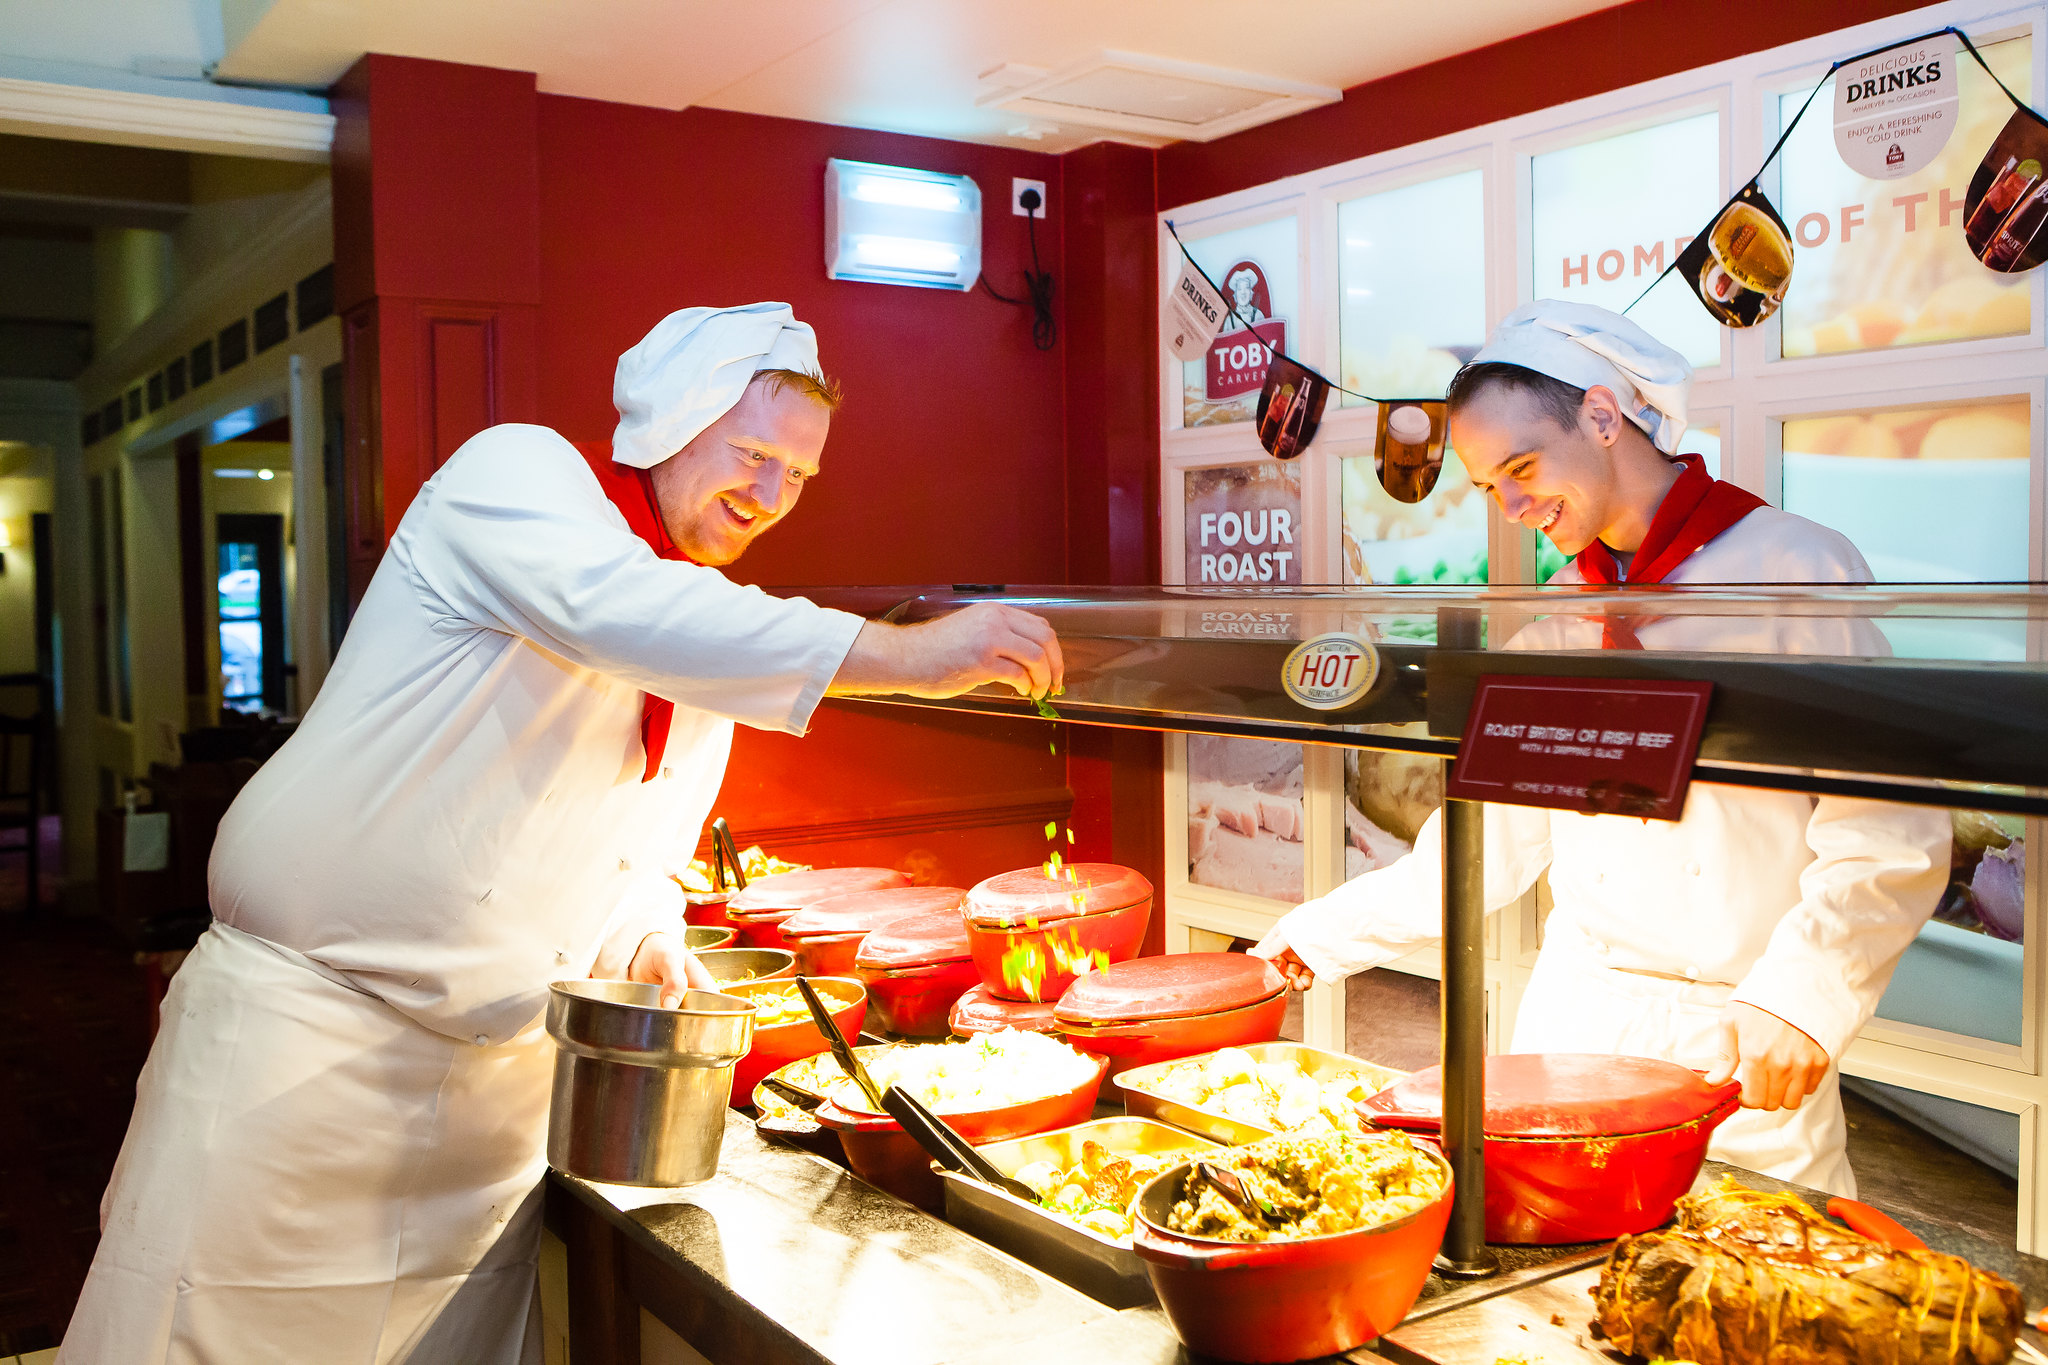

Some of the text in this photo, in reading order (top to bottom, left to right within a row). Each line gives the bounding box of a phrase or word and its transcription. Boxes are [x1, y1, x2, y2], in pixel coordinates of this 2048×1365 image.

[1860, 50, 1926, 78] DELICIOUS
[1846, 60, 1942, 104] DRINKS
[1896, 88, 1936, 102] OCCASION
[1847, 110, 1943, 139] ENJOY A REFRESHING
[1866, 125, 1922, 144] COLD DRINK
[1795, 203, 1865, 249] OF
[1892, 184, 1969, 233] TH
[1181, 276, 1218, 324] DRINKS
[1214, 339, 1278, 373] TOBY
[1217, 369, 1268, 387] CARVER
[1200, 508, 1294, 548] FOUR
[1200, 551, 1294, 583] ROAST
[1201, 611, 1294, 622] ROAST
[1201, 621, 1291, 634] CARVERY
[1298, 654, 1360, 688] HOT
[1483, 722, 1675, 749] ROAST BRITISH OR IRISH BEEF
[1540, 783, 1555, 794] OF
